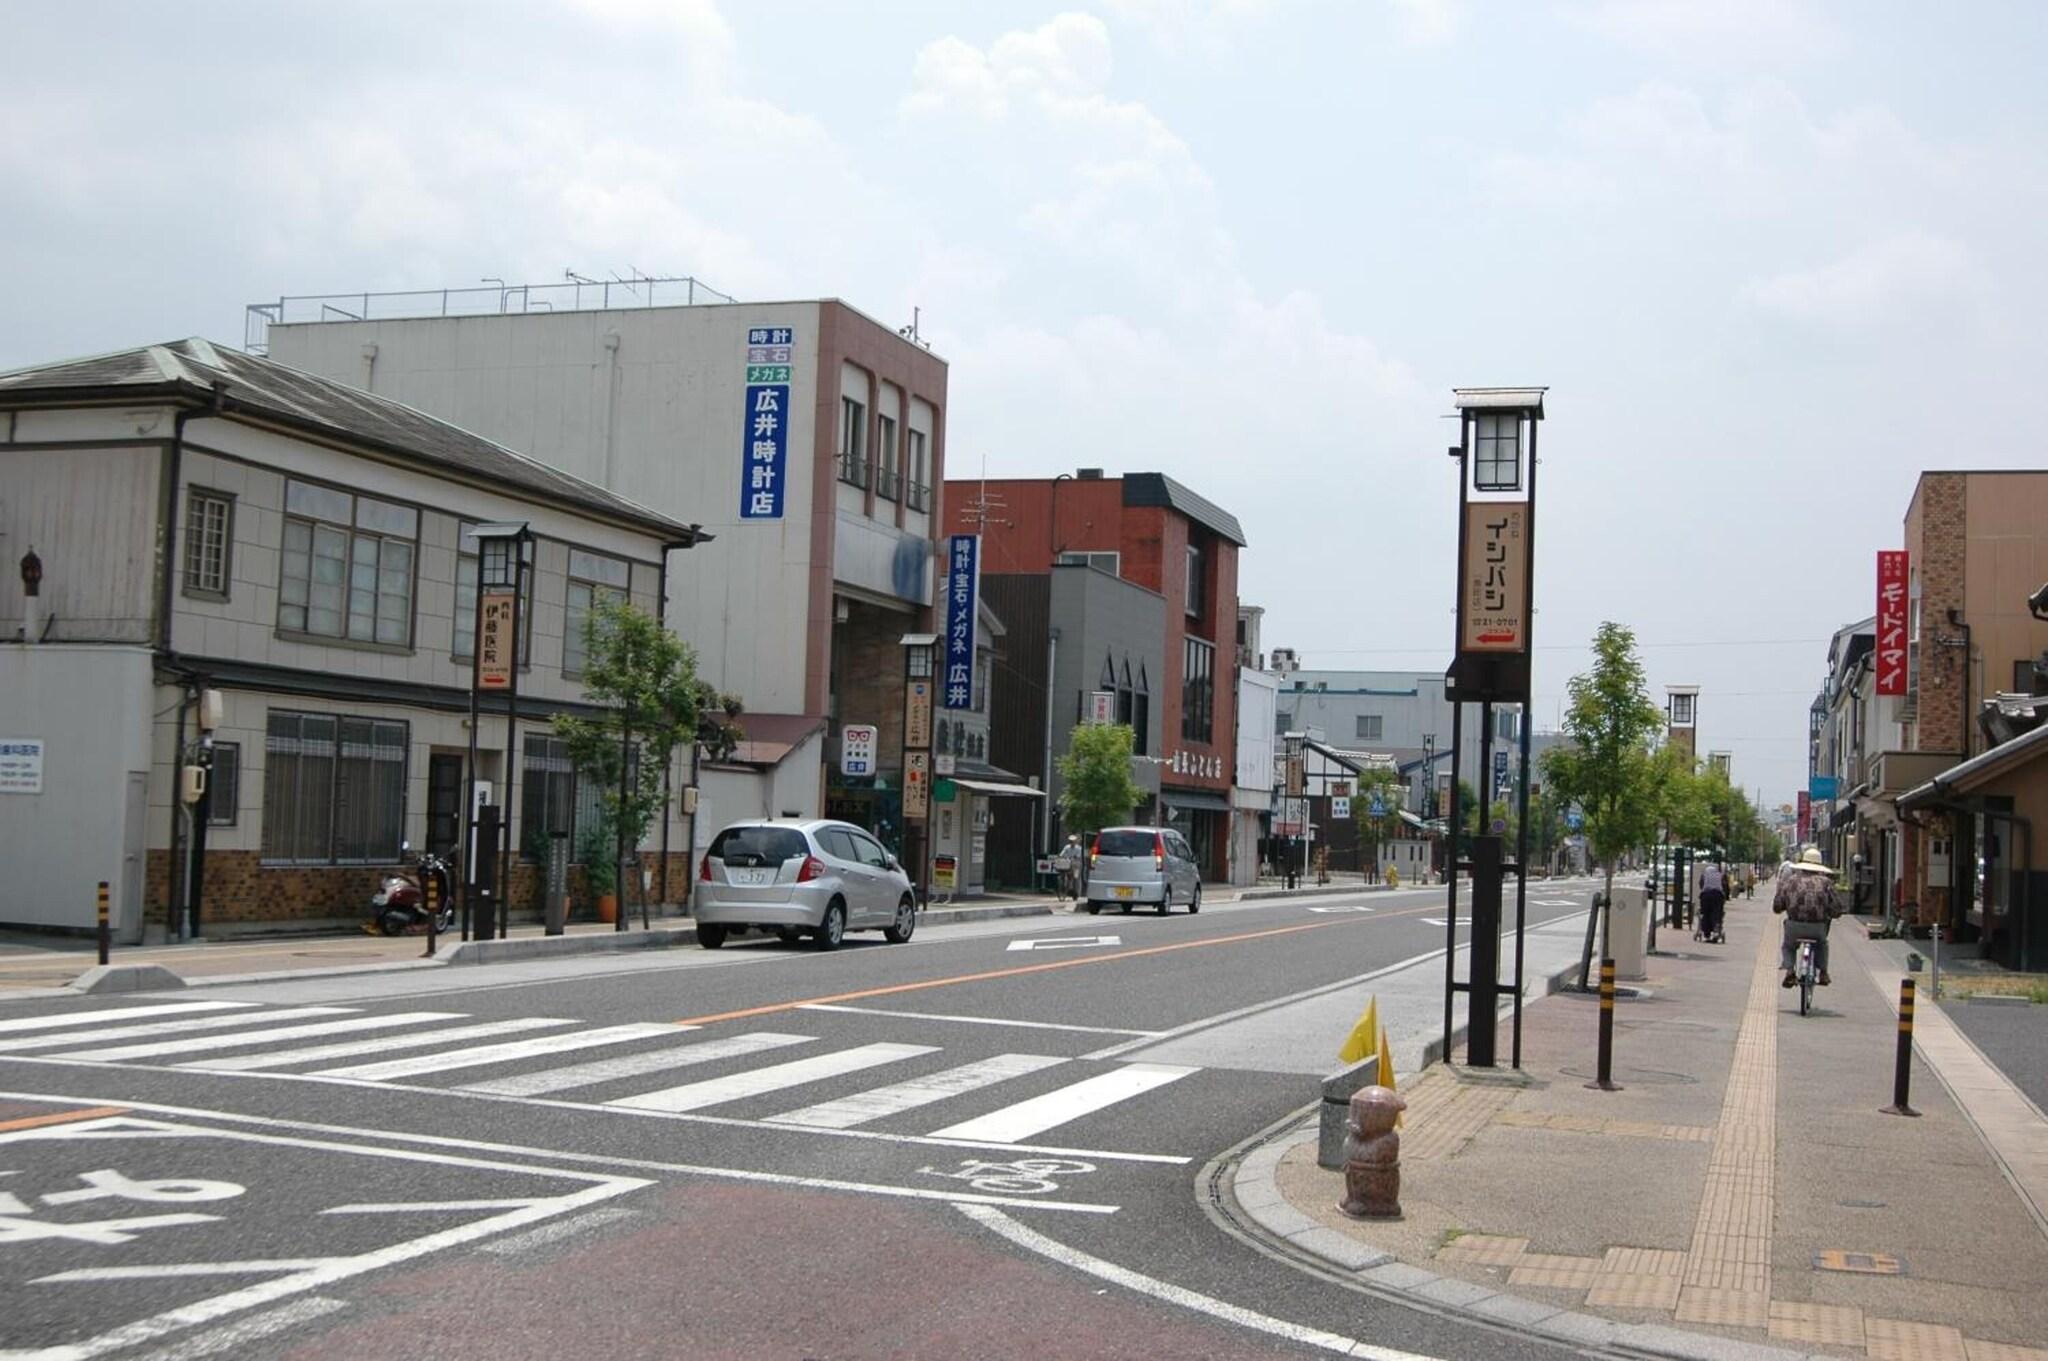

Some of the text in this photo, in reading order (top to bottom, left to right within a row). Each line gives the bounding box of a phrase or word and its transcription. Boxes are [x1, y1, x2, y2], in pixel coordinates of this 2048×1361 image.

[751, 329, 789, 343] 時計
[751, 348, 788, 362] 宝石
[751, 367, 788, 381] メガネ
[750, 388, 780, 514] 広井時計店
[1485, 518, 1507, 610] イシバシ
[484, 604, 499, 664] 伊藤医院
[1881, 582, 1904, 690] モードイマイ
[948, 663, 969, 706] 広井
[0, 744, 40, 757] 歯科医院
